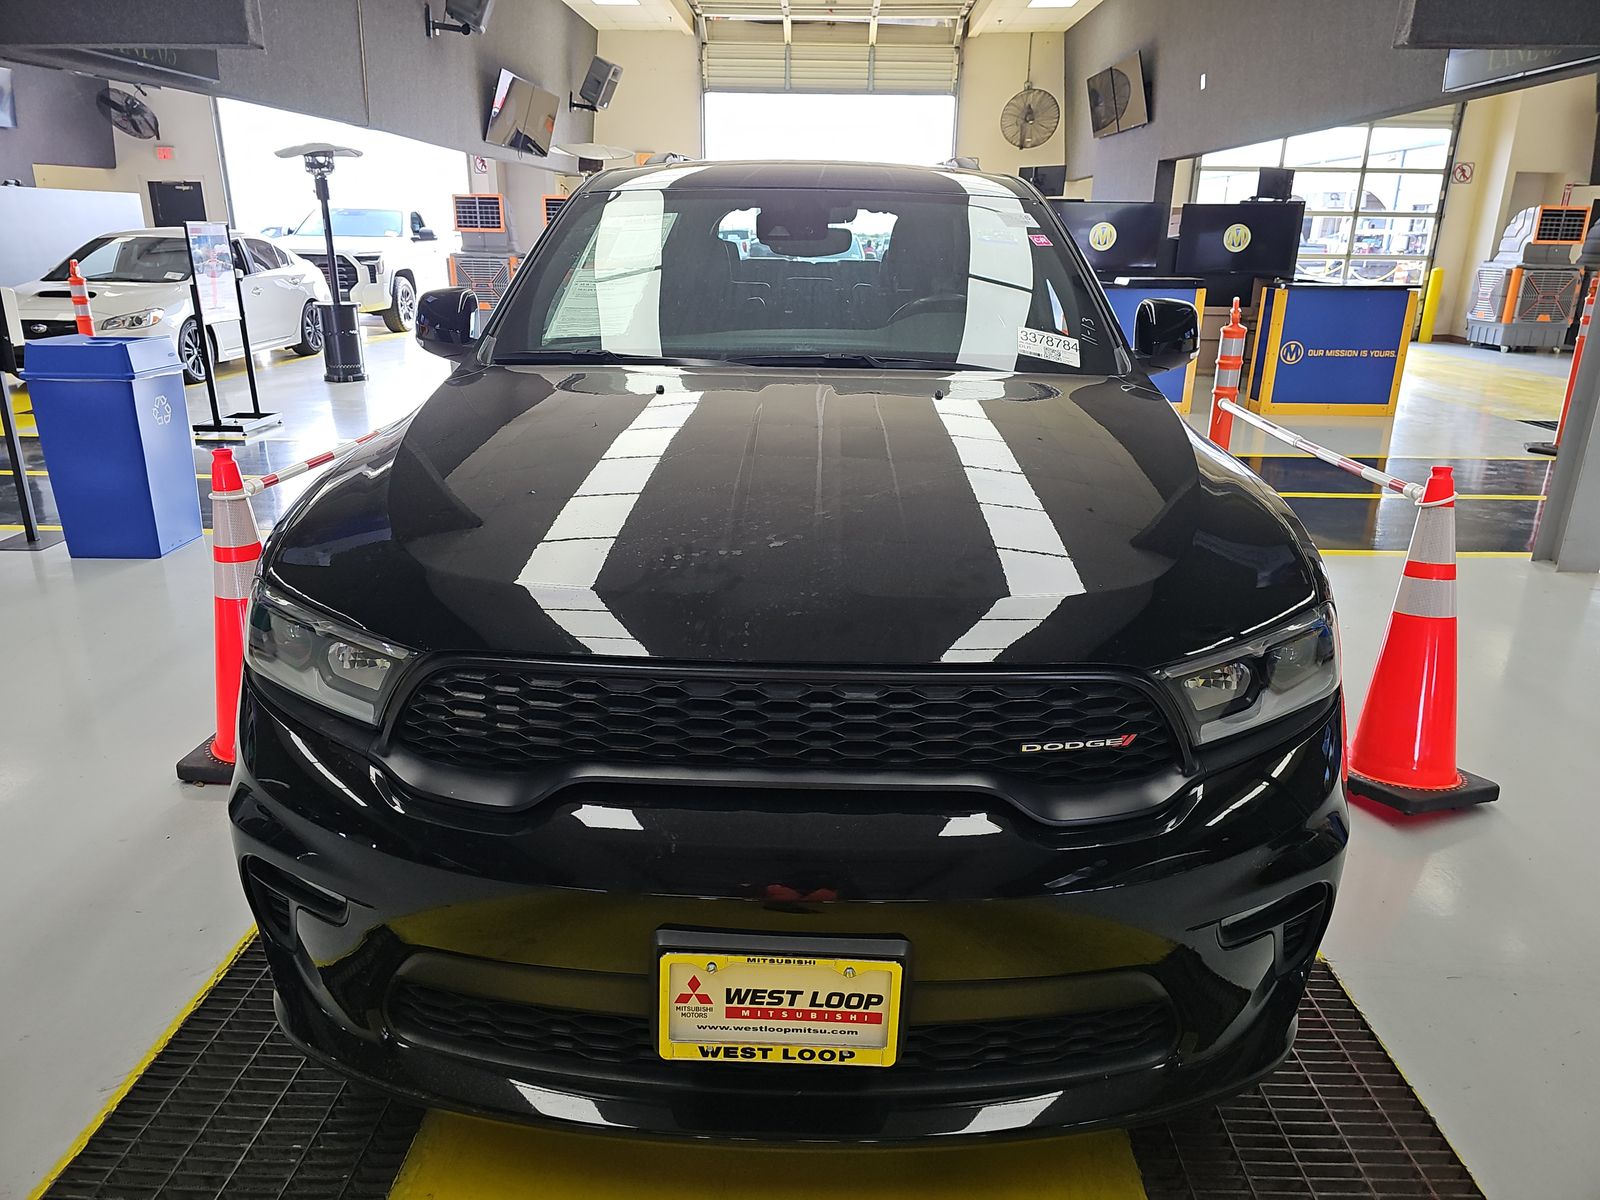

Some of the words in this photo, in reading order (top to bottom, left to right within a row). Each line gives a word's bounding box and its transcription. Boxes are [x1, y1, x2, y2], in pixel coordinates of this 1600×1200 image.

[1020, 330, 1079, 353] 3378784
[1307, 349, 1324, 357] OUR
[1325, 349, 1359, 357] MISSION
[1360, 349, 1368, 357] IS
[1370, 350, 1397, 358] YOURS.
[1021, 738, 1123, 752] DODGE
[746, 957, 817, 965] MITSUBISHI
[725, 987, 804, 1006] WEST
[809, 990, 884, 1010] LOOP
[675, 1005, 714, 1013] MITSUBISHI
[741, 1009, 869, 1022] MITSUBISHI
[696, 1023, 859, 1036] www.westloopmitsu.com
[698, 1045, 774, 1060] WEST
[782, 1047, 856, 1063] LOOP
